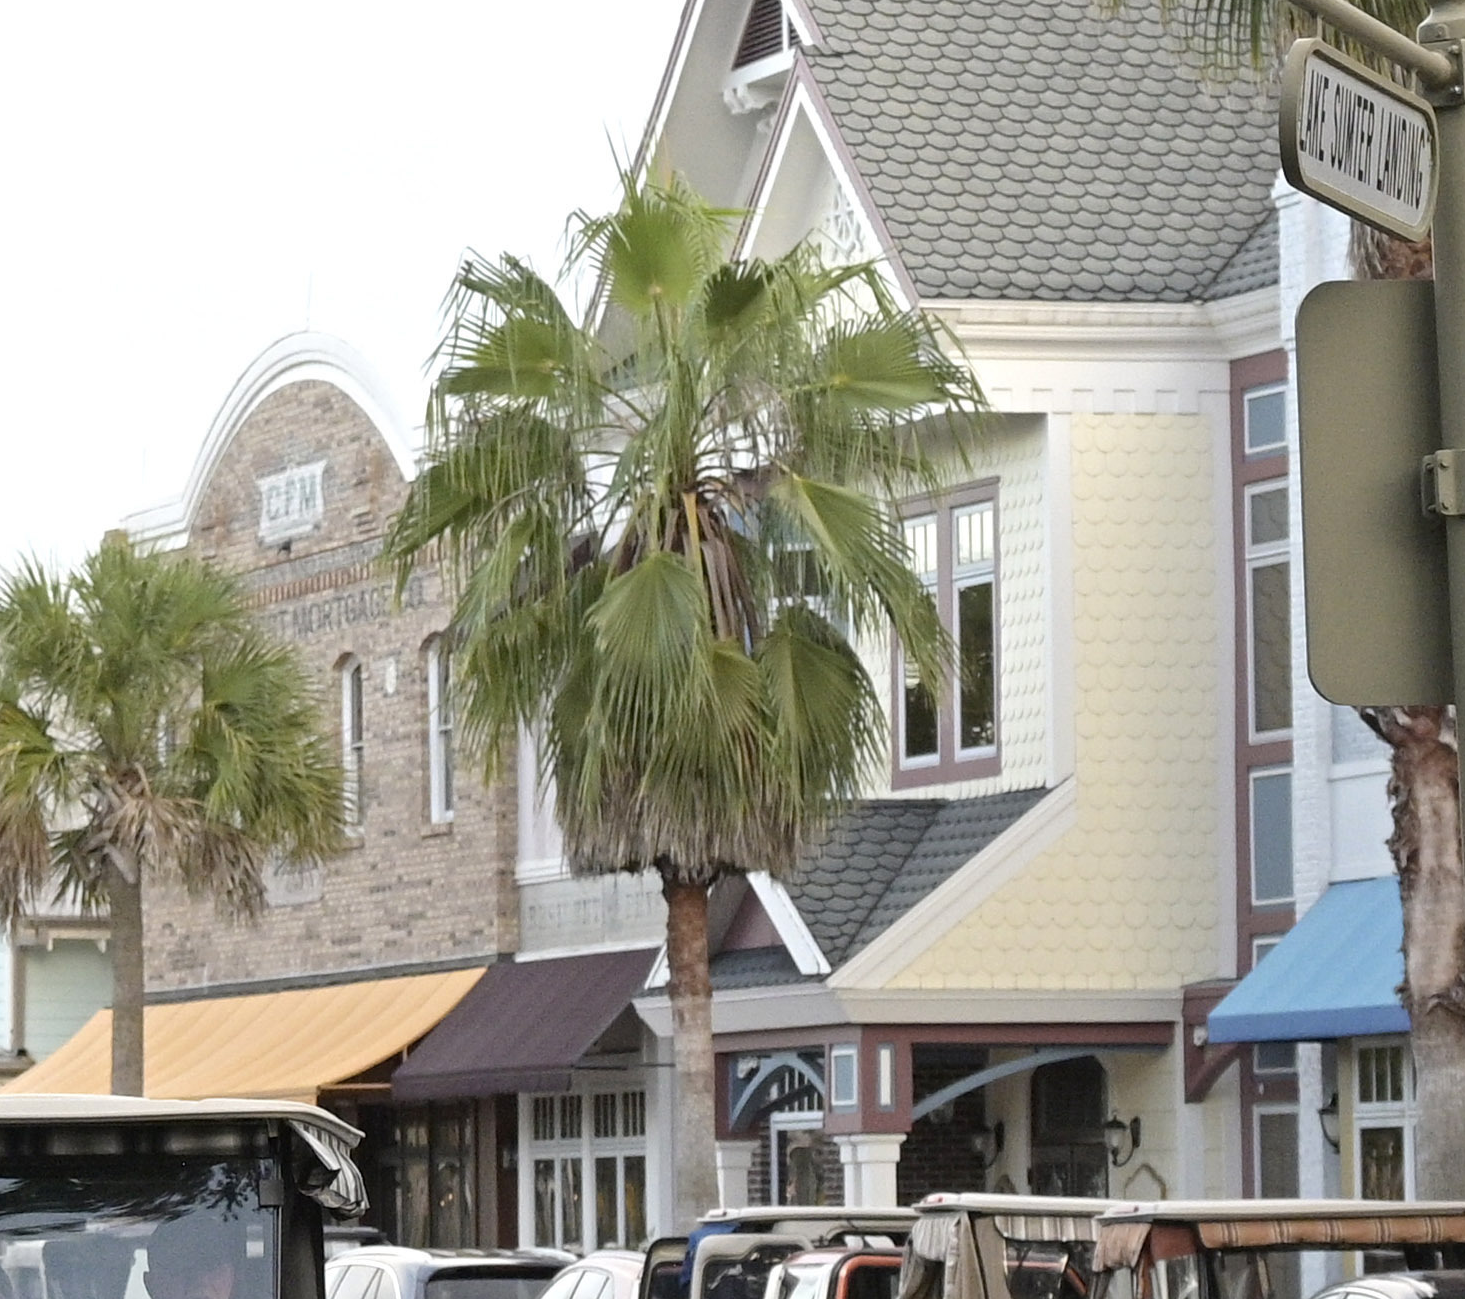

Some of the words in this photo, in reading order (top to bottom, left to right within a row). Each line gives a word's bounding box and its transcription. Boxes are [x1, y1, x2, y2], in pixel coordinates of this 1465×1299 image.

[1299, 67, 1330, 163] LAKE
[1330, 83, 1376, 186] SUMTER
[1376, 107, 1426, 210] LANDING
